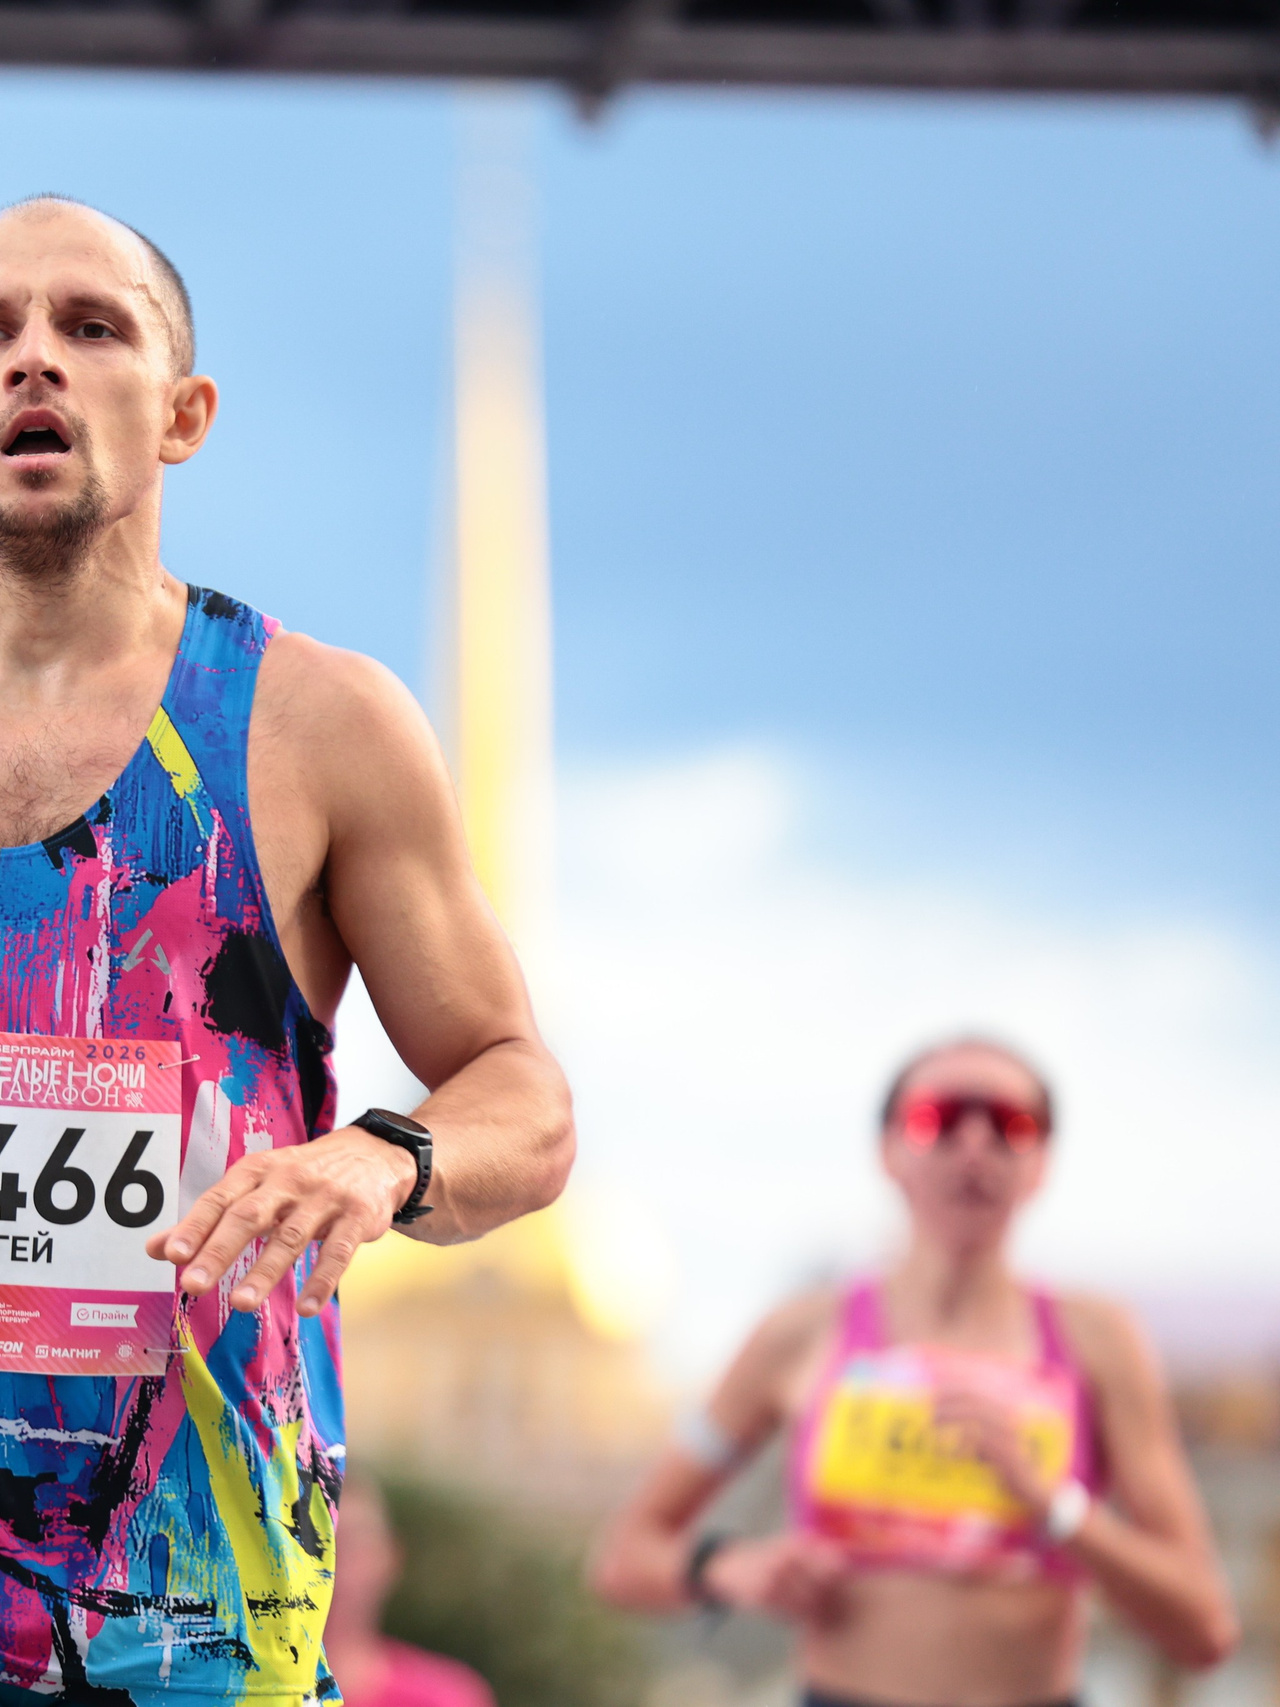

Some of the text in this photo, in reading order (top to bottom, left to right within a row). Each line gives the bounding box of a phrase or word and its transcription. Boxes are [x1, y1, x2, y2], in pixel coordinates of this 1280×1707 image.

[86, 1044, 146, 1060] 2026
[67, 1061, 146, 1089] НОЧИ
[92, 1309, 129, 1321] Прайм
[51, 1347, 101, 1359] МАГНИТ
